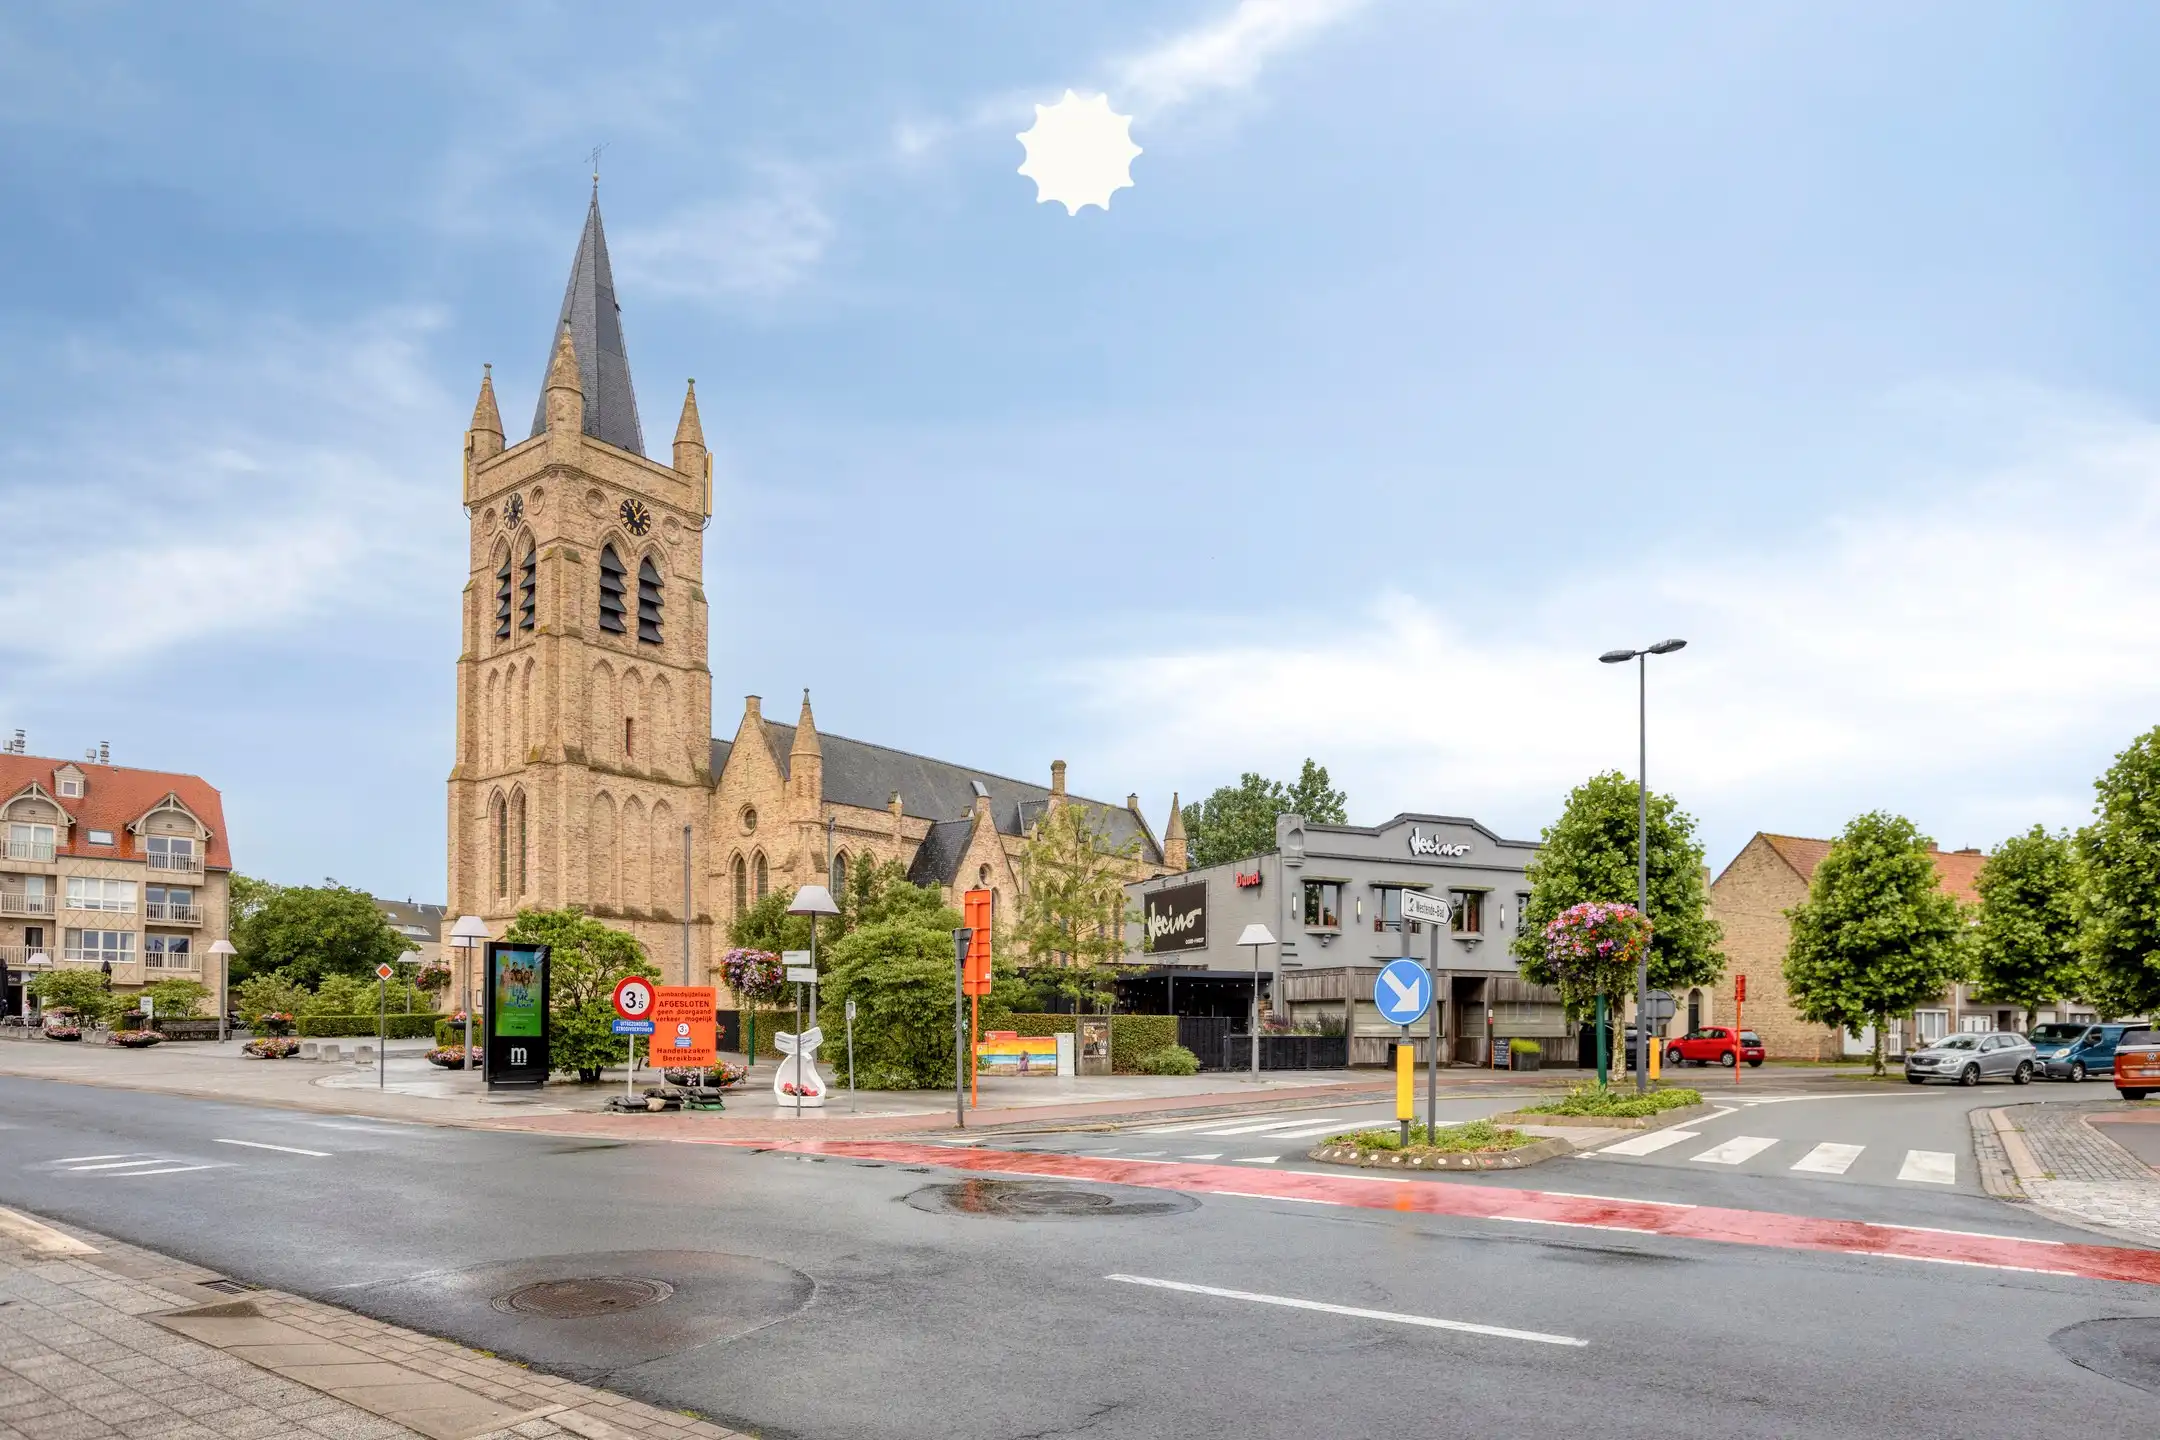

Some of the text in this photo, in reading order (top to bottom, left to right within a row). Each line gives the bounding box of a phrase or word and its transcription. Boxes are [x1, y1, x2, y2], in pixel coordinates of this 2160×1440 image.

[1409, 827, 1471, 857] Vecino
[1236, 871, 1260, 889] Duvel
[1416, 900, 1445, 918] Westende-Bad
[1147, 901, 1202, 943] Vecino
[625, 991, 636, 1009] 3
[638, 1000, 644, 1009] 5
[658, 1000, 710, 1008] AFGESLOTEN
